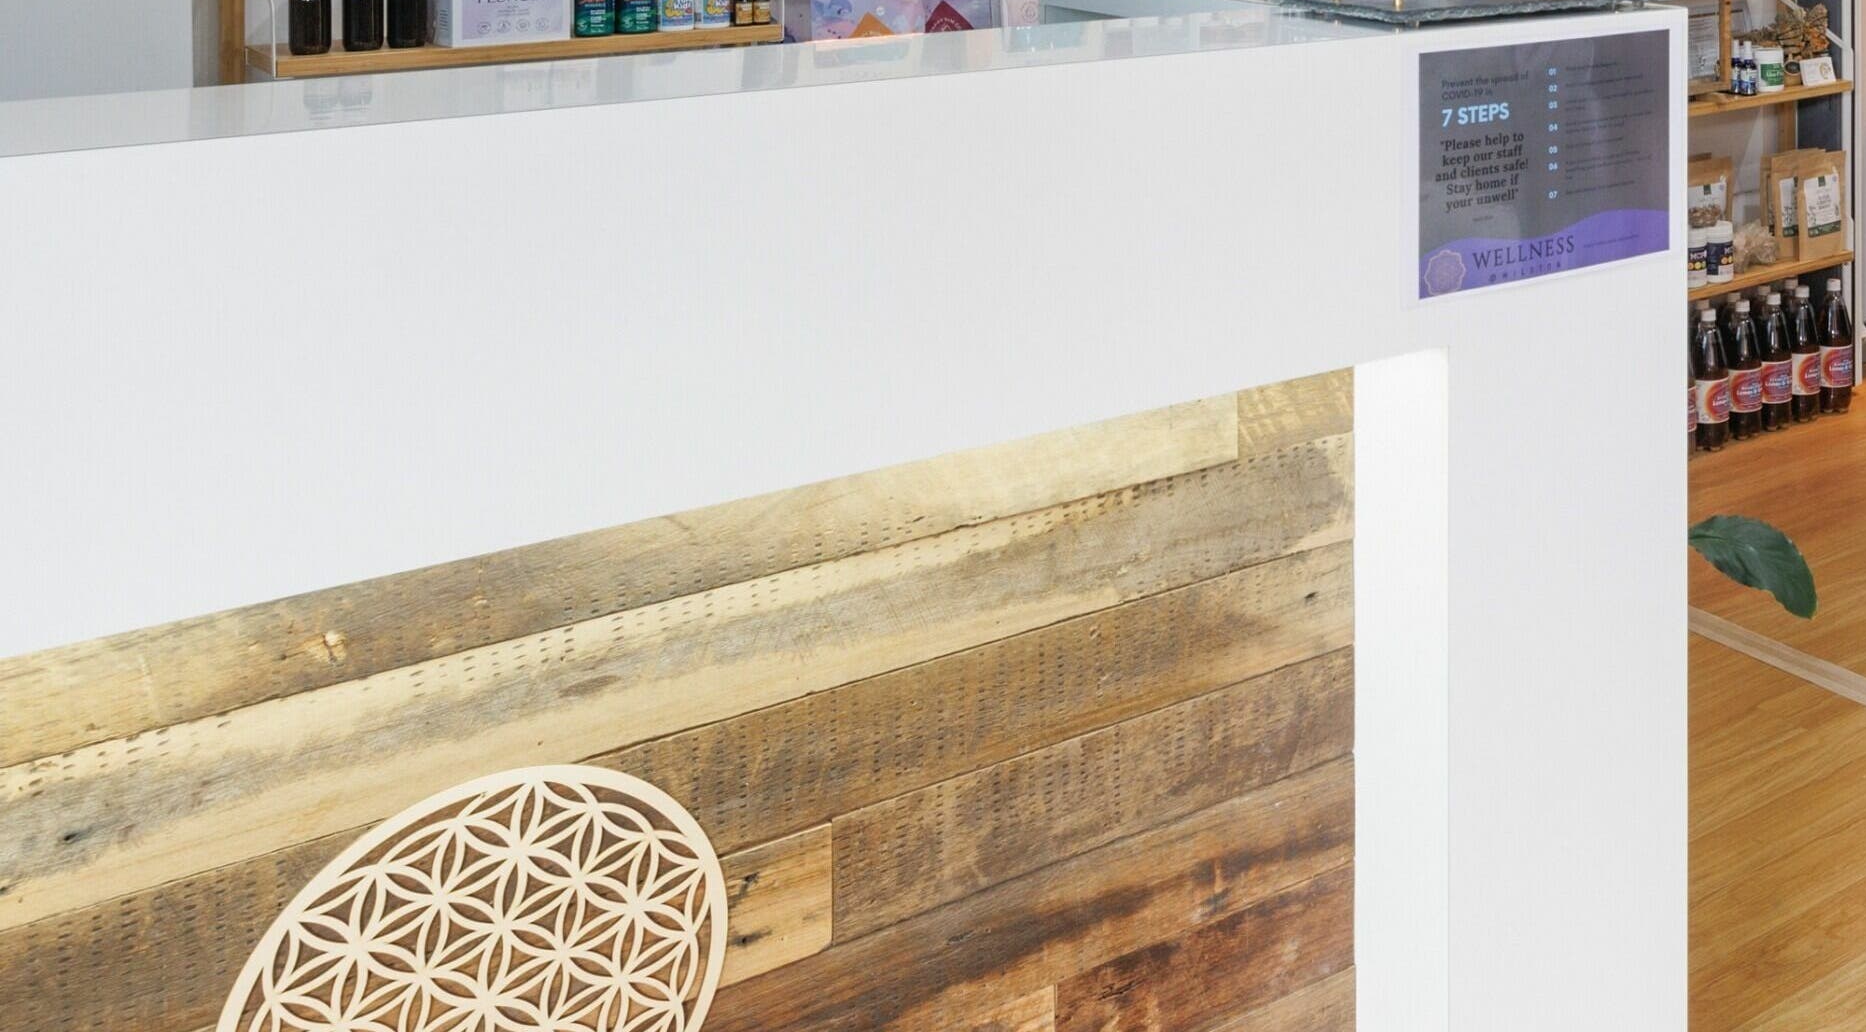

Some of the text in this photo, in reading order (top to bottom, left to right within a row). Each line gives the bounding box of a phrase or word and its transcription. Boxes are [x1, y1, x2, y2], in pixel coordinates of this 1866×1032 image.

[1441, 70, 1528, 88] Prevent the spread of
[1548, 68, 1558, 76] 01
[1441, 88, 1484, 100] COVID-19
[1548, 85, 1558, 93] 02
[1548, 101, 1558, 109] 03
[1441, 102, 1510, 127] 7 STEPS
[1548, 123, 1558, 132] 04
[1441, 132, 1525, 151] "Please help to
[1442, 144, 1523, 167] keep our staff
[1548, 146, 1558, 154] 05
[1435, 158, 1528, 182] and clients safe!
[1548, 162, 1558, 171] 06
[1446, 173, 1519, 196] Stay home if
[1445, 188, 1520, 213] your unwell"
[1548, 191, 1558, 199] 07
[1472, 235, 1576, 270] WELLNESS
